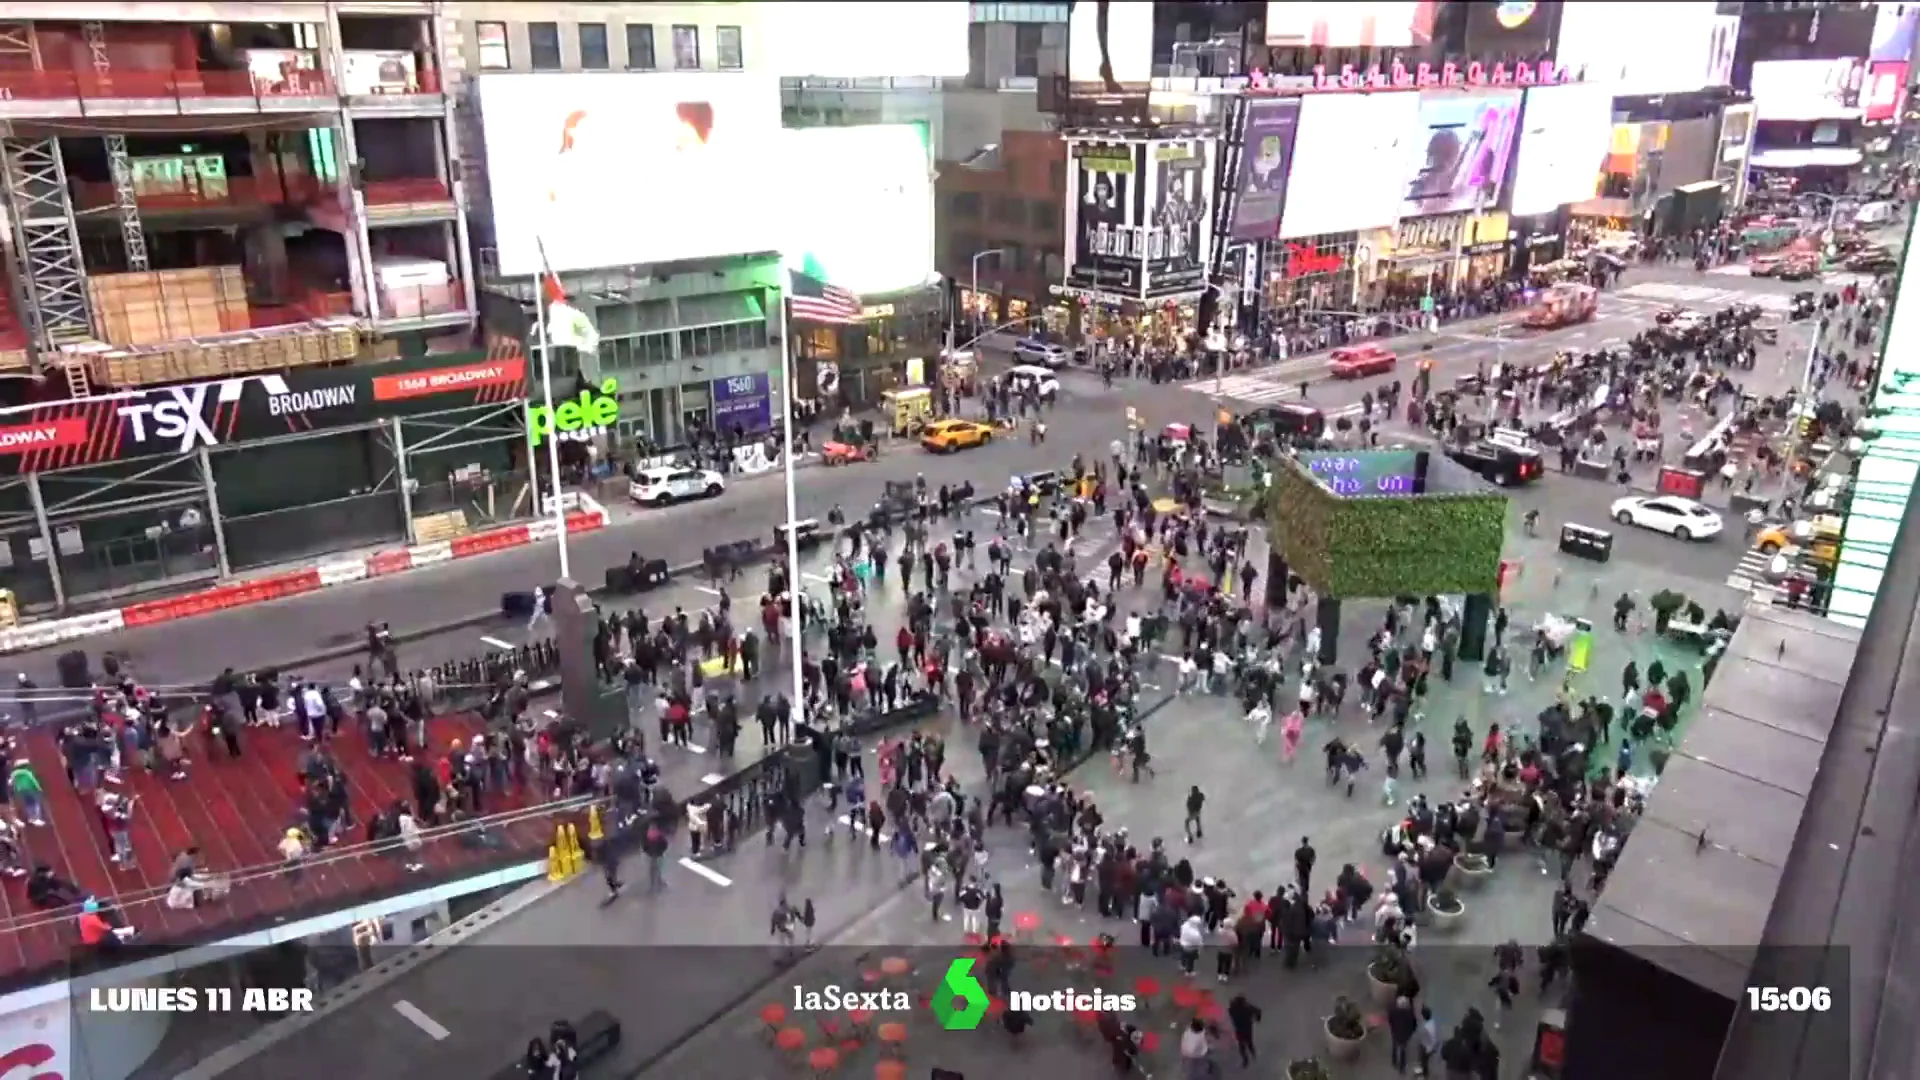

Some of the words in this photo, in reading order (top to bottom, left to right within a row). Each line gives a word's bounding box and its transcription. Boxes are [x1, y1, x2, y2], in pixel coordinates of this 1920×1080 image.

[429, 366, 503, 387] BROADWAY
[268, 384, 357, 416] BROADWAY
[117, 386, 219, 452] TSX
[0, 428, 57, 446] DWAY
